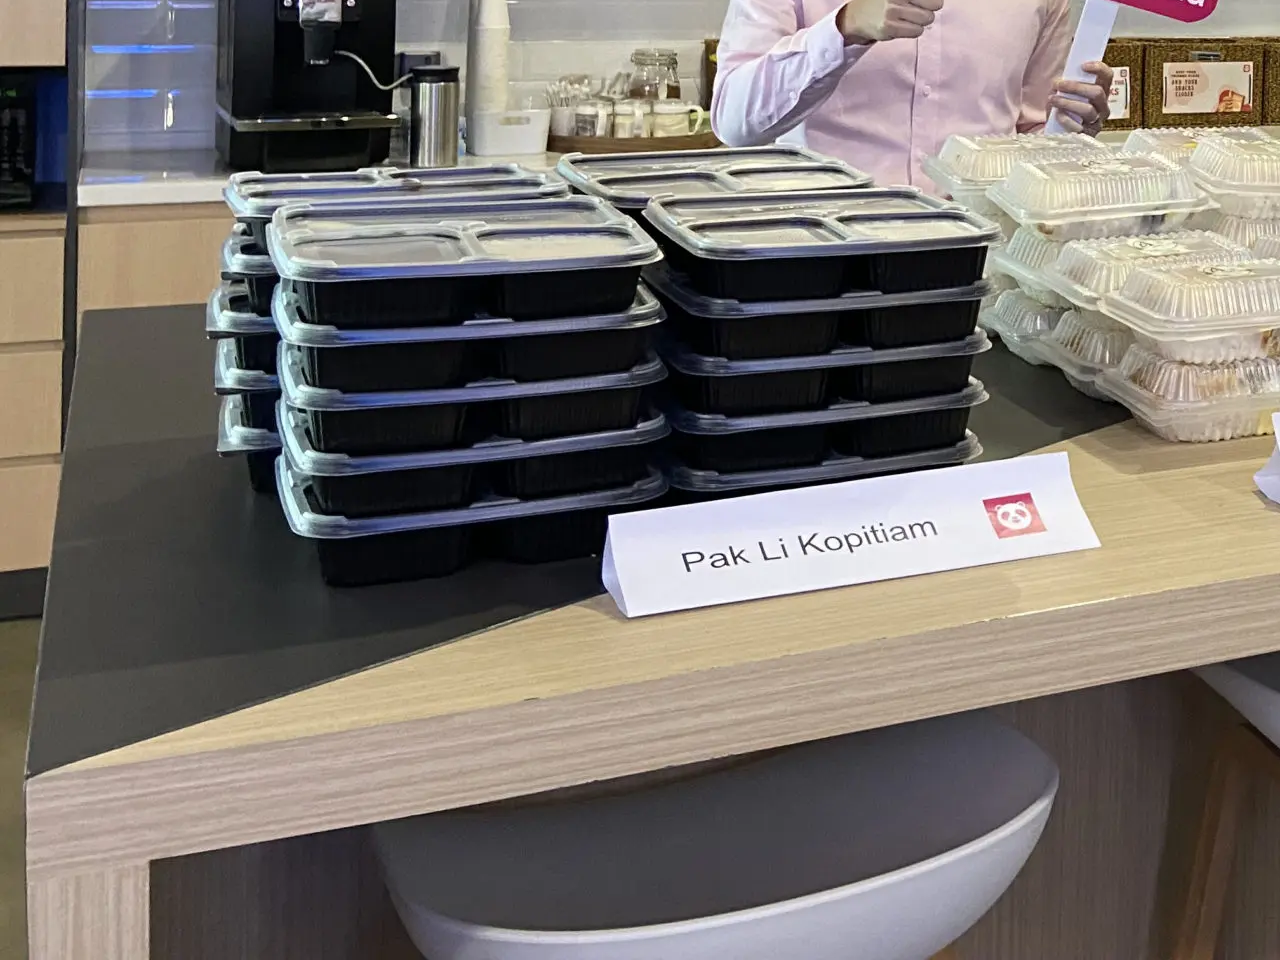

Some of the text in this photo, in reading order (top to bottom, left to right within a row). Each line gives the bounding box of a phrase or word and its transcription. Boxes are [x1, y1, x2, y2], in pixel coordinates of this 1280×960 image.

[681, 518, 938, 573] Pak Li Kopitiam
